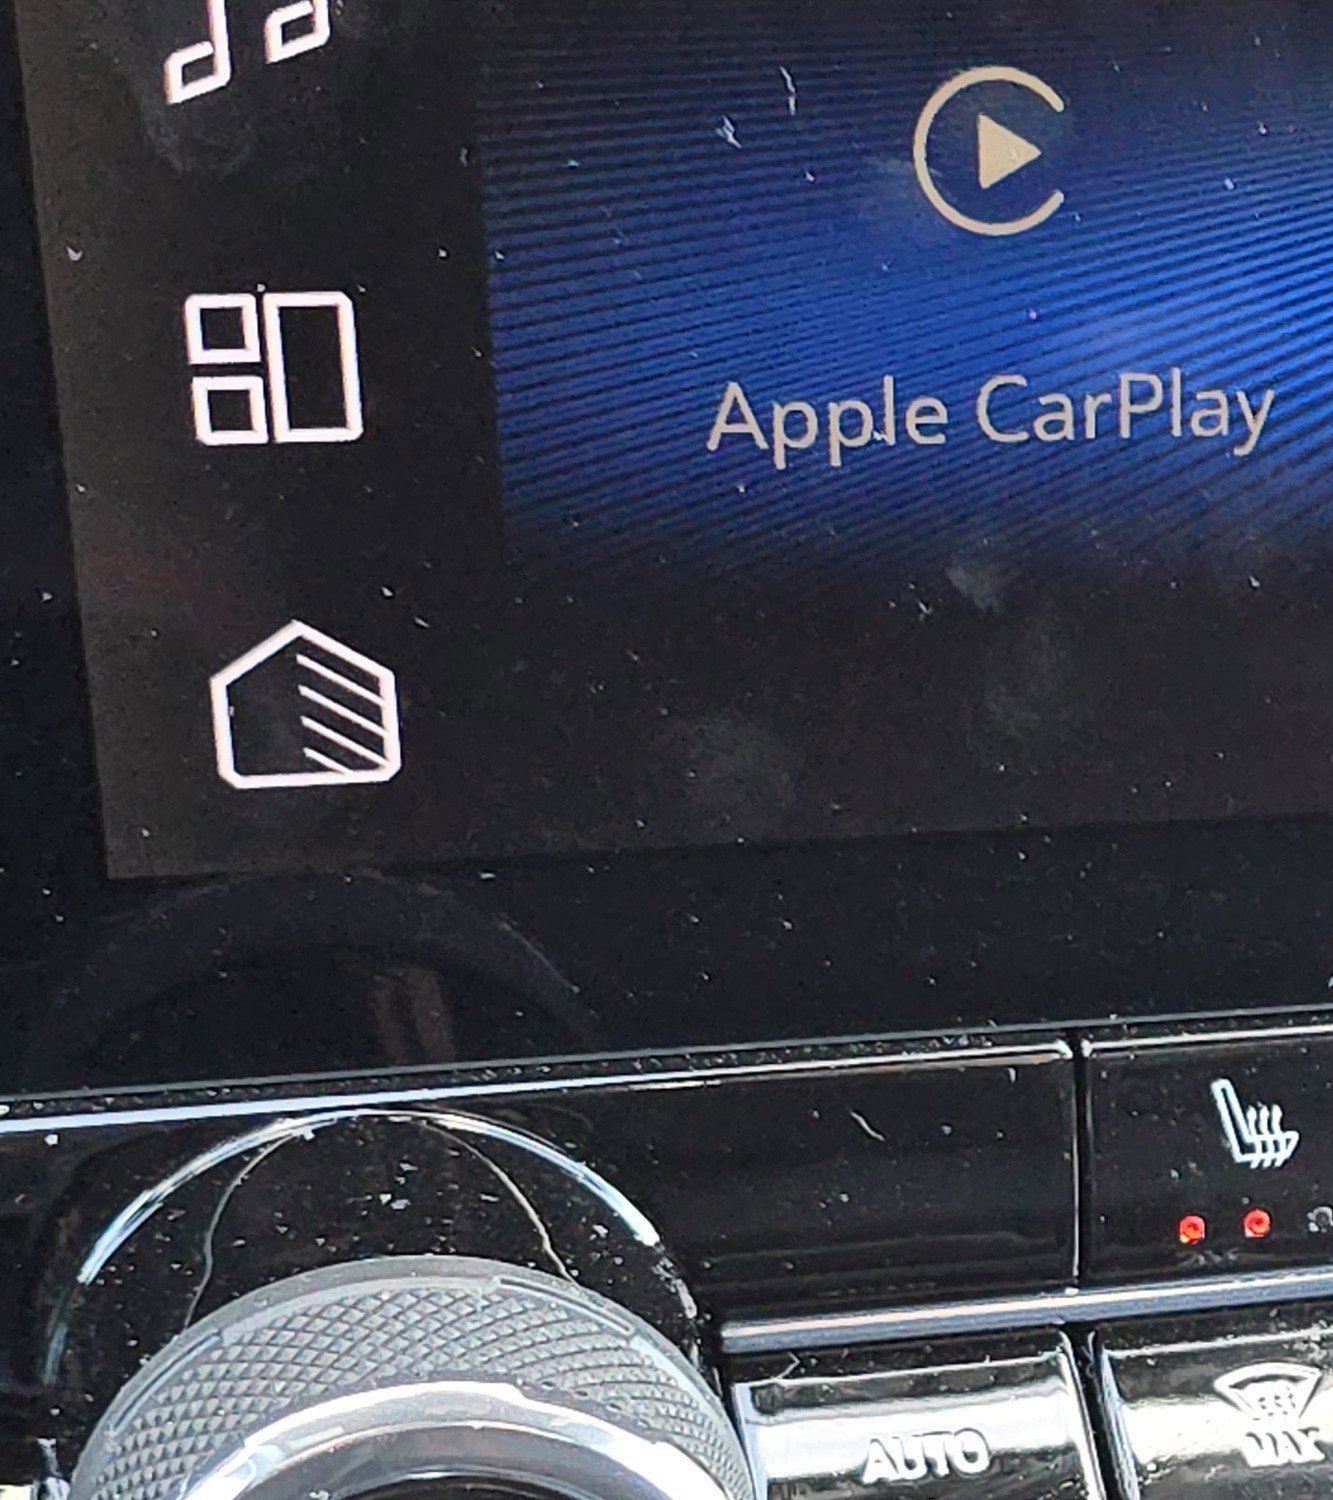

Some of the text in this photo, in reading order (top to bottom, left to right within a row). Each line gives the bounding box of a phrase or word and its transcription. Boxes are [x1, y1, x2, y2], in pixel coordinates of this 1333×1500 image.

[706, 366, 1277, 469] Apple CarPlay
[861, 1426, 991, 1486] AUTO
